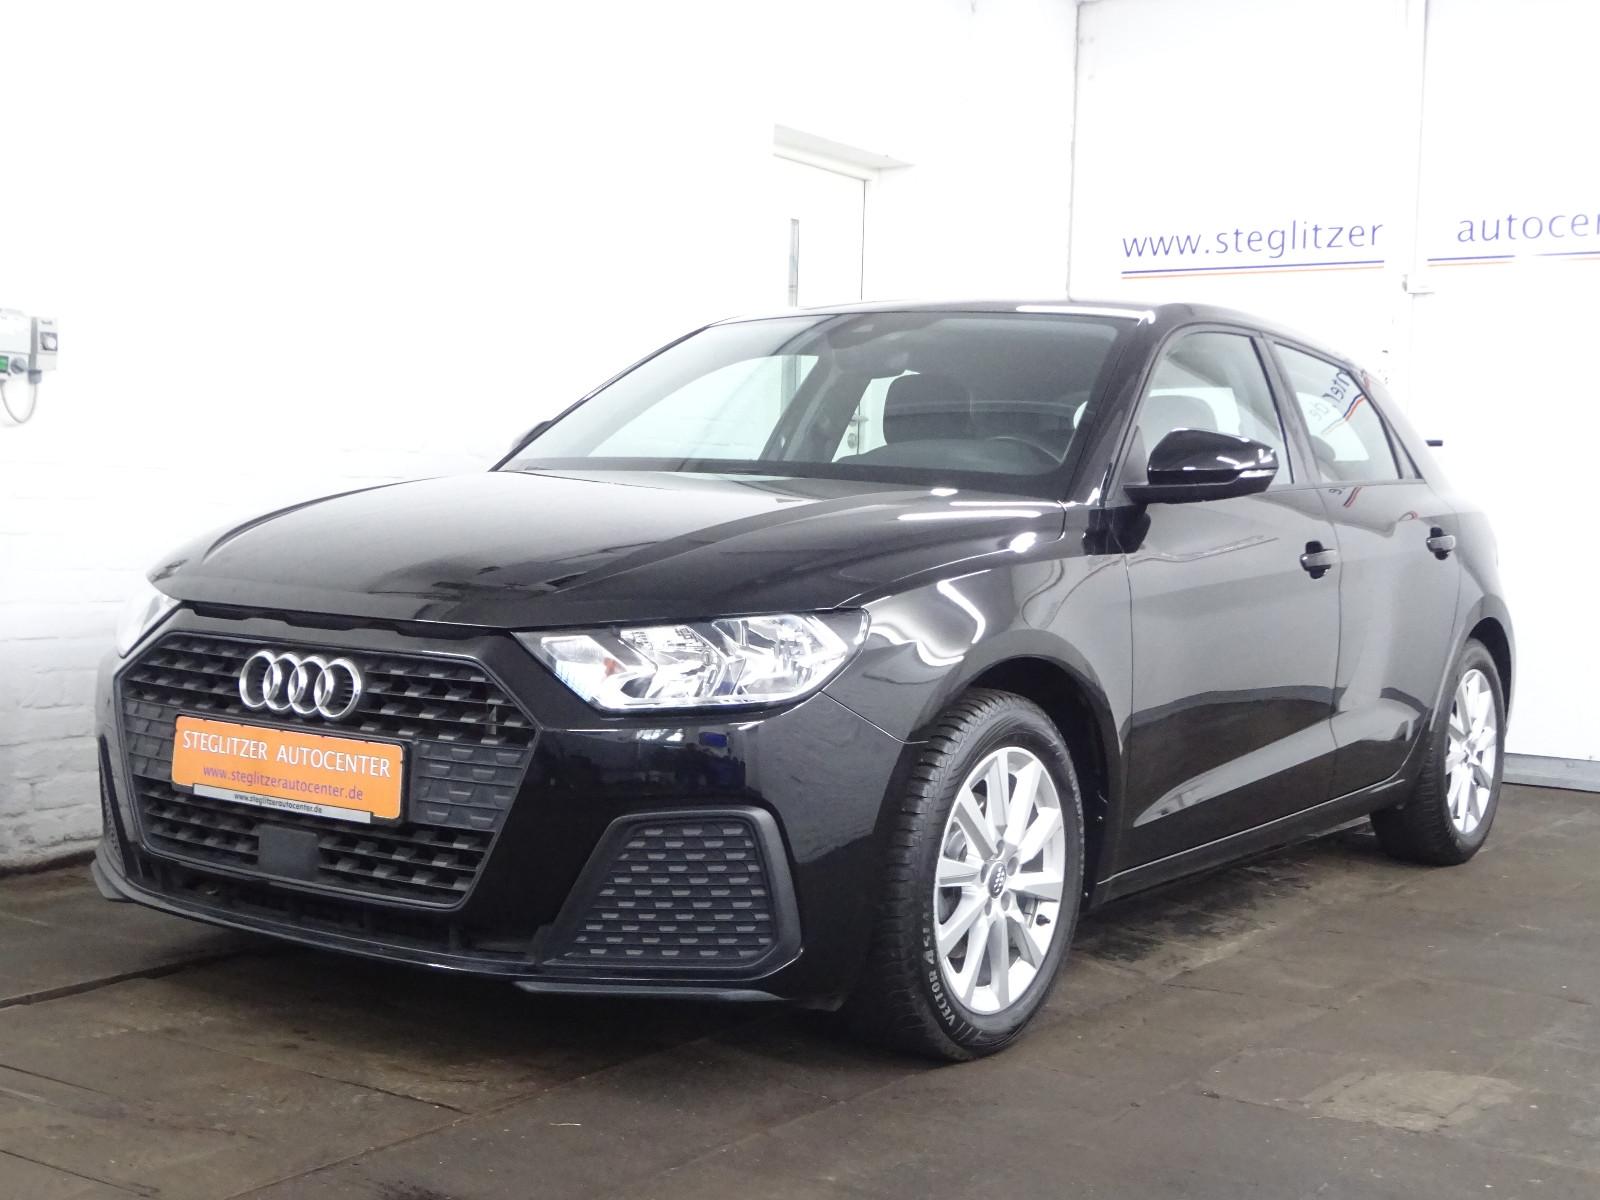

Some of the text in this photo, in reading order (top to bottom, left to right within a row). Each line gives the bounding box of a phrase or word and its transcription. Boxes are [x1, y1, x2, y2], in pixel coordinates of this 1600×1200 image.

[1122, 219, 1384, 259] www.steglitzer
[183, 730, 391, 778] STEGLITZER AUTOCENTER
[202, 765, 363, 801] www.steglitzerautocenter.de
[233, 793, 322, 813] www.steglitzerautocenter.de
[928, 969, 956, 1026] VECTOR
